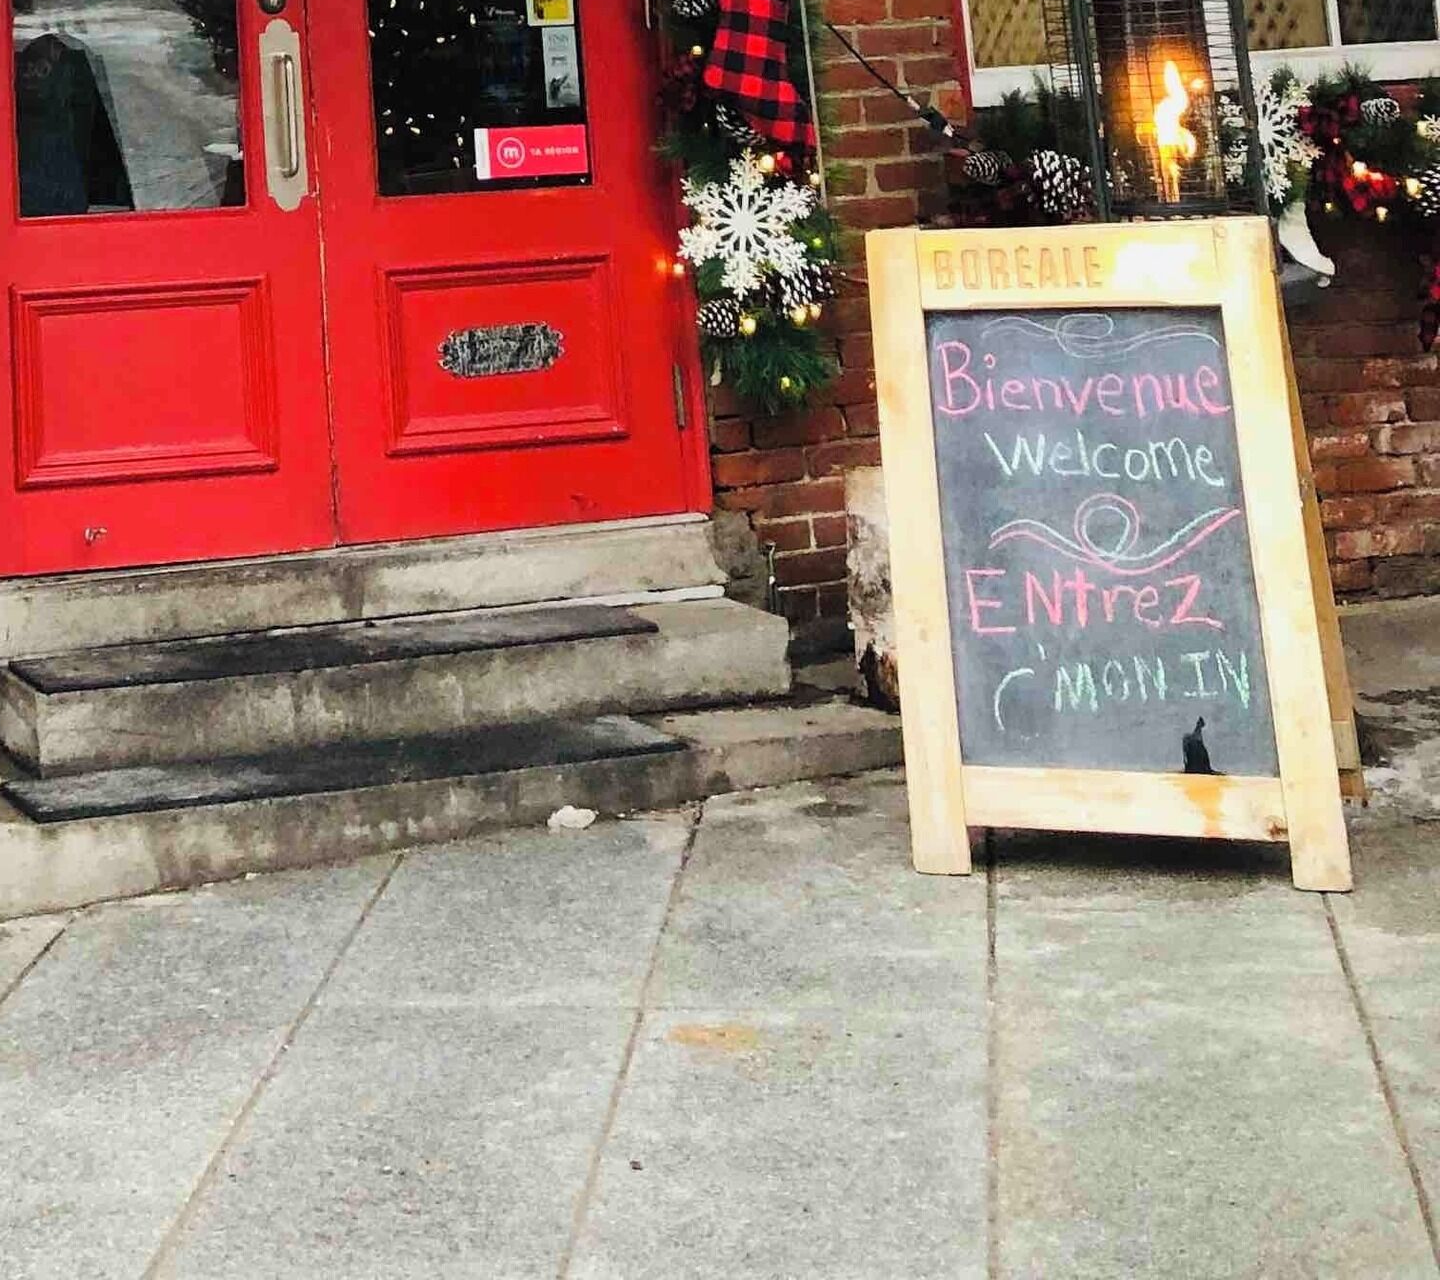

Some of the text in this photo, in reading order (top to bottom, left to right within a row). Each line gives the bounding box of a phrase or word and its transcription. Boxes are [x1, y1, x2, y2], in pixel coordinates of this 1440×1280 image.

[936, 341, 1231, 416] Bienvenue
[983, 429, 1225, 487] Welcome
[1180, 648, 1250, 710] IN
